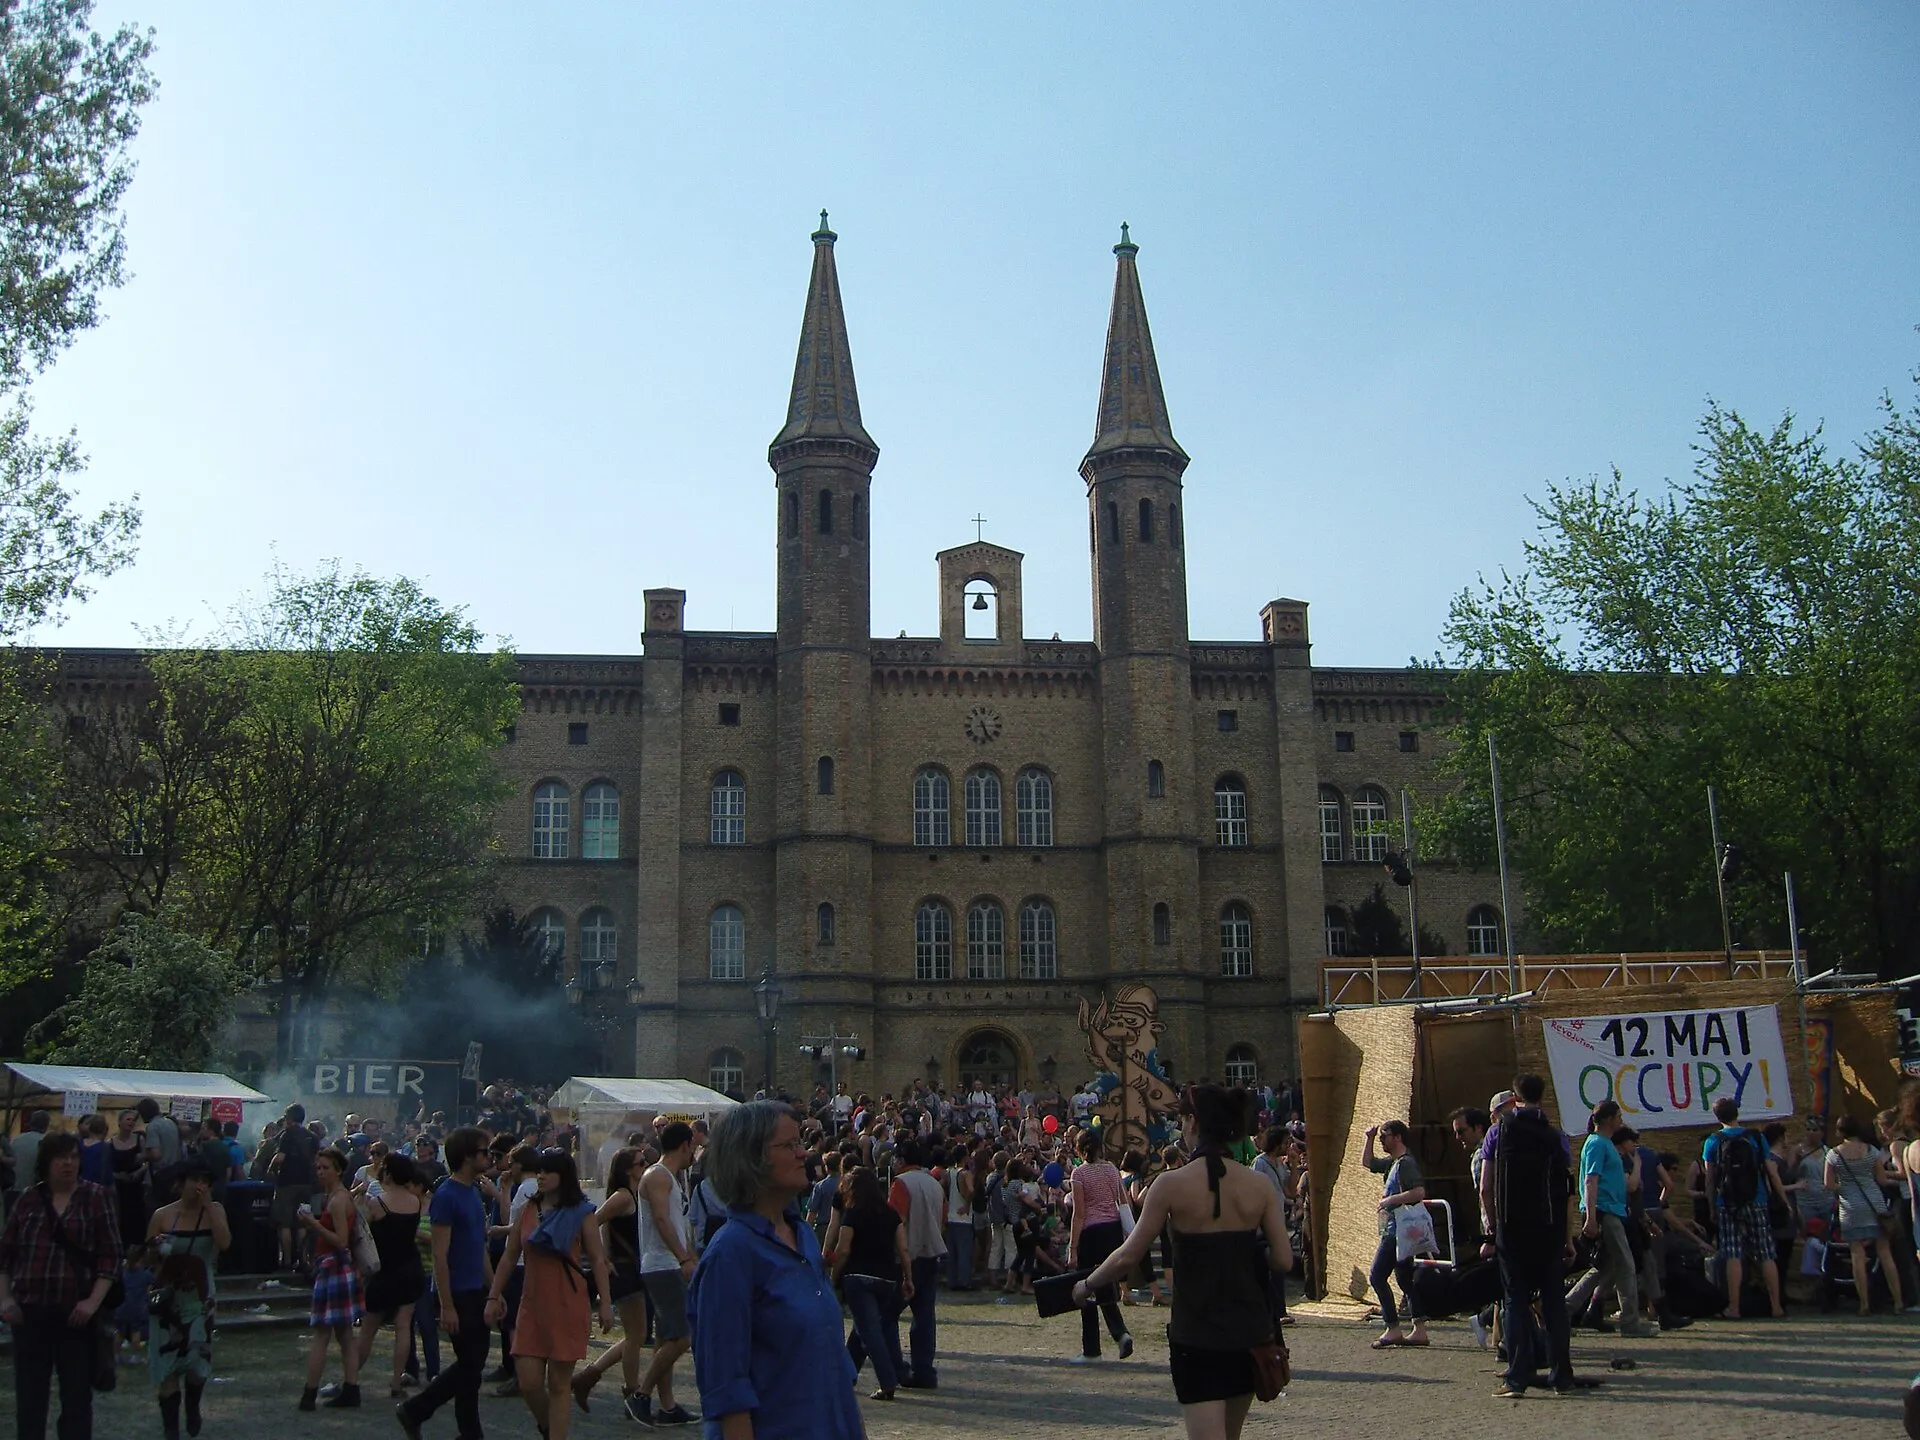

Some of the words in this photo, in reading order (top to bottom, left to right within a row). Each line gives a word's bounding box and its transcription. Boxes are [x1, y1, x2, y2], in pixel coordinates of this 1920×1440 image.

[907, 990, 1072, 1001] BETHANIEN
[1600, 1016, 1655, 1057] 12.
[1664, 1010, 1751, 1057] MAI
[1578, 1058, 1774, 1114] OCCUPY!
